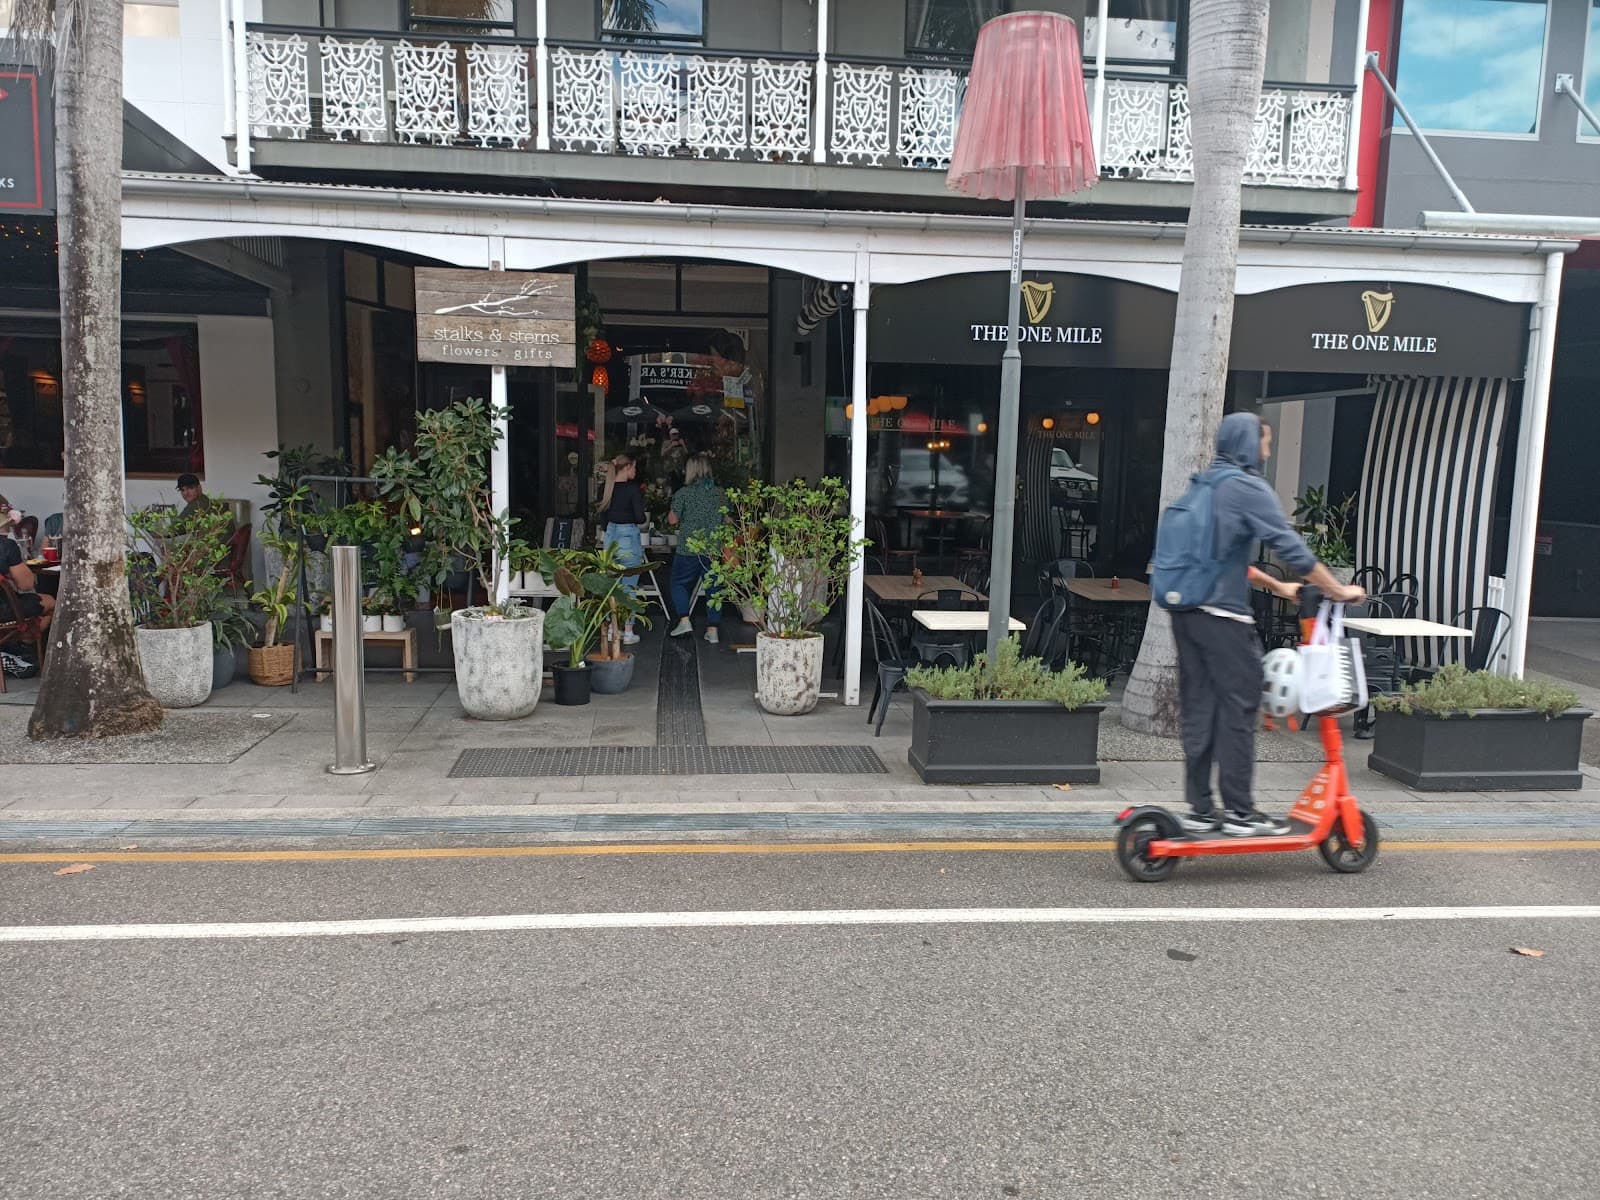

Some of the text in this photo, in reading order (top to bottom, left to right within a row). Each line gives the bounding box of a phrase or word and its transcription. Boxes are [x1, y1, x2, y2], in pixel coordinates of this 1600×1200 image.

[433, 326, 560, 345] stalks & stems
[970, 324, 1009, 341] THE
[1056, 327, 1102, 343] MILE
[1311, 333, 1437, 353] THE ONE MILE
[442, 345, 553, 361] flowers gifts
